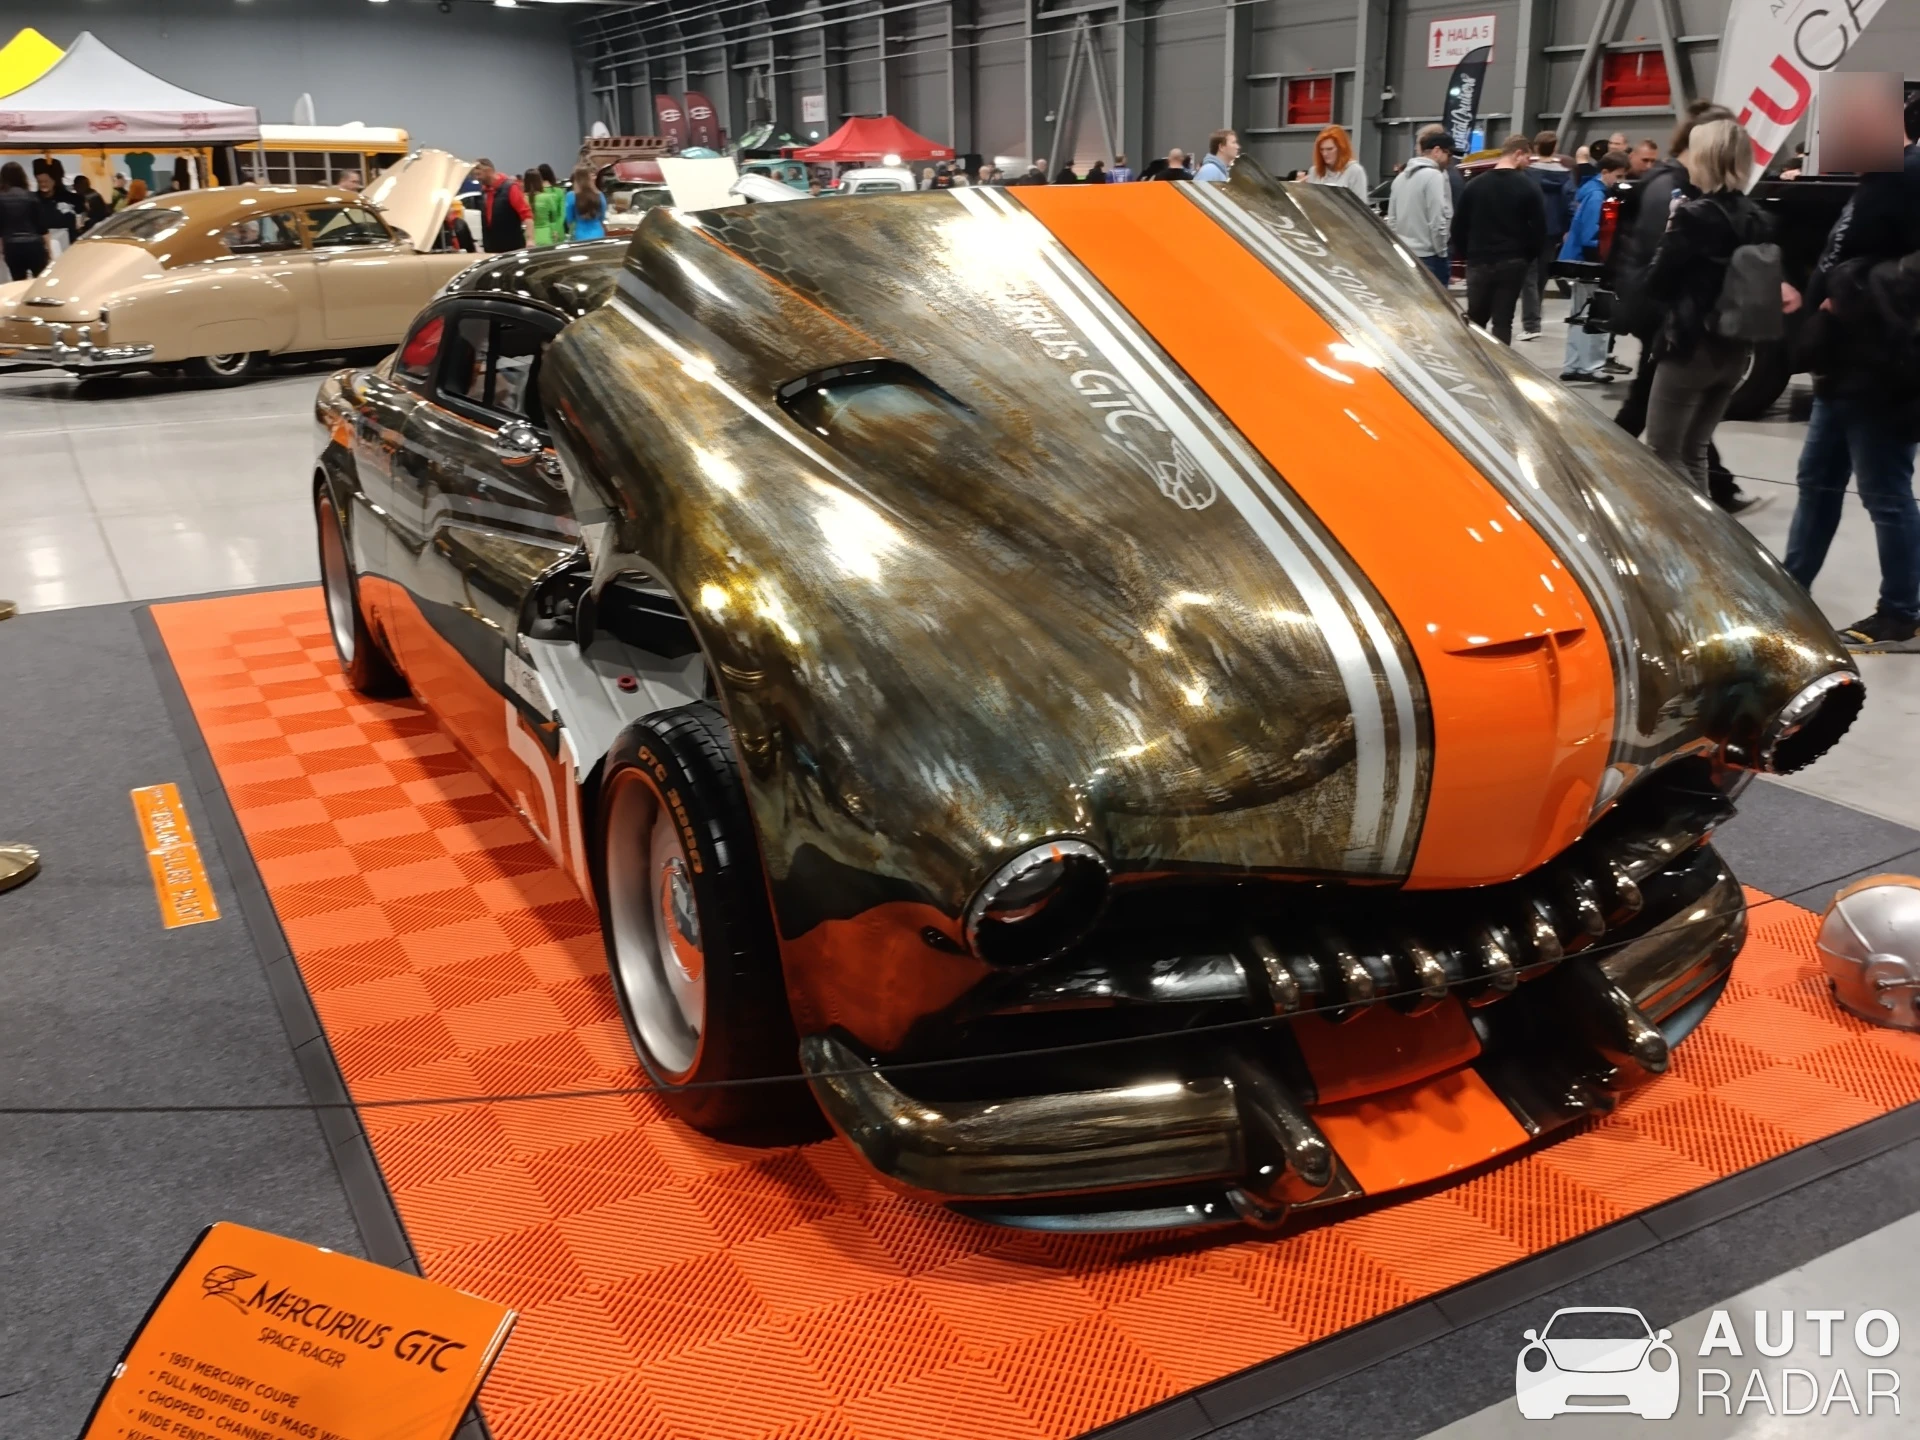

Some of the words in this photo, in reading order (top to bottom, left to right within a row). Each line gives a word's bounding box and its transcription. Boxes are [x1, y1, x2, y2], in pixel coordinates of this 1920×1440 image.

[1446, 47, 1464, 57] HALL
[1447, 26, 1480, 42] HALA
[1481, 25, 1489, 39] 5
[1070, 369, 1169, 435] GTC
[247, 1279, 393, 1350] MERCURIUS
[394, 1329, 468, 1374] GTC
[257, 1326, 300, 1353] SPACE
[297, 1341, 347, 1370] RACER
[156, 1370, 187, 1393] FULL
[189, 1383, 251, 1414] MODIFIED
[260, 1409, 279, 1425] US
[279, 1415, 319, 1440] MAGS
[168, 1351, 194, 1370] 1951
[193, 1361, 255, 1393] MERCURY
[254, 1384, 300, 1409] COUPE
[138, 1409, 172, 1432] WIDE
[147, 1390, 206, 1420] CHOPPED
[215, 1415, 287, 1440] CHANNE
